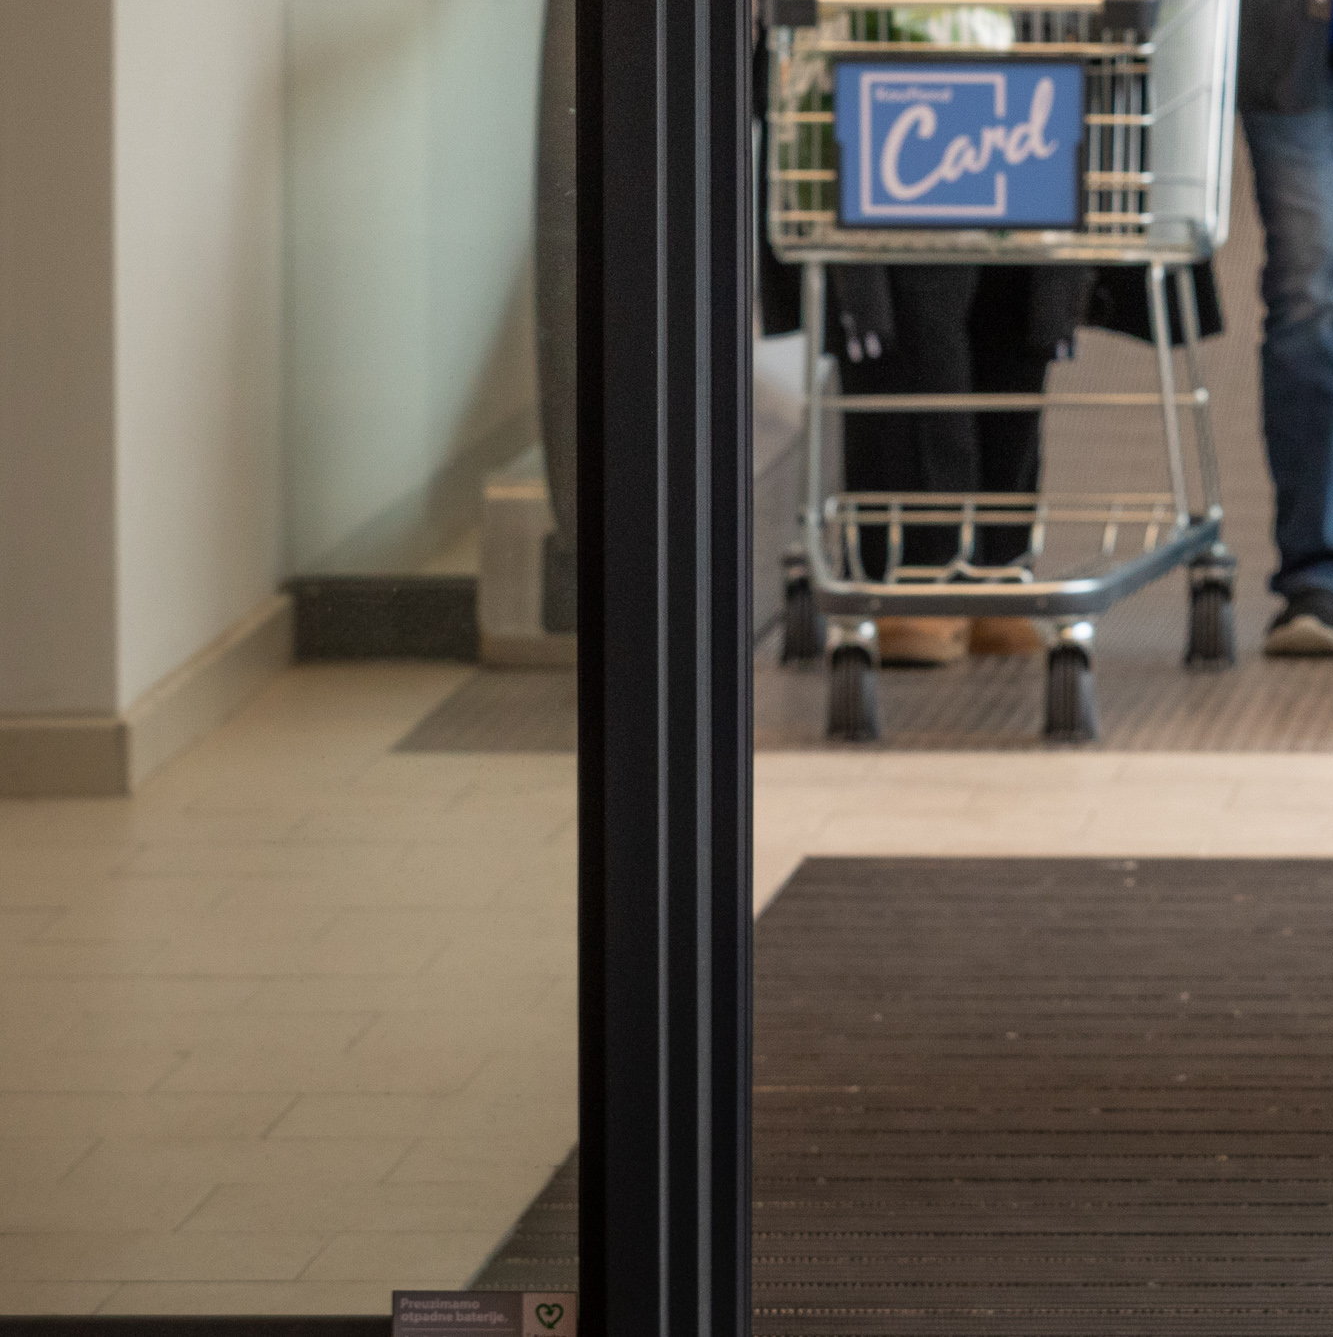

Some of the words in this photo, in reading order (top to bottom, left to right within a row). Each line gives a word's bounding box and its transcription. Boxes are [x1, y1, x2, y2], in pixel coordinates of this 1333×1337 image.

[881, 78, 1057, 200] Card
[400, 1298, 480, 1310] Preuzimamo
[400, 1312, 454, 1324] otpadne
